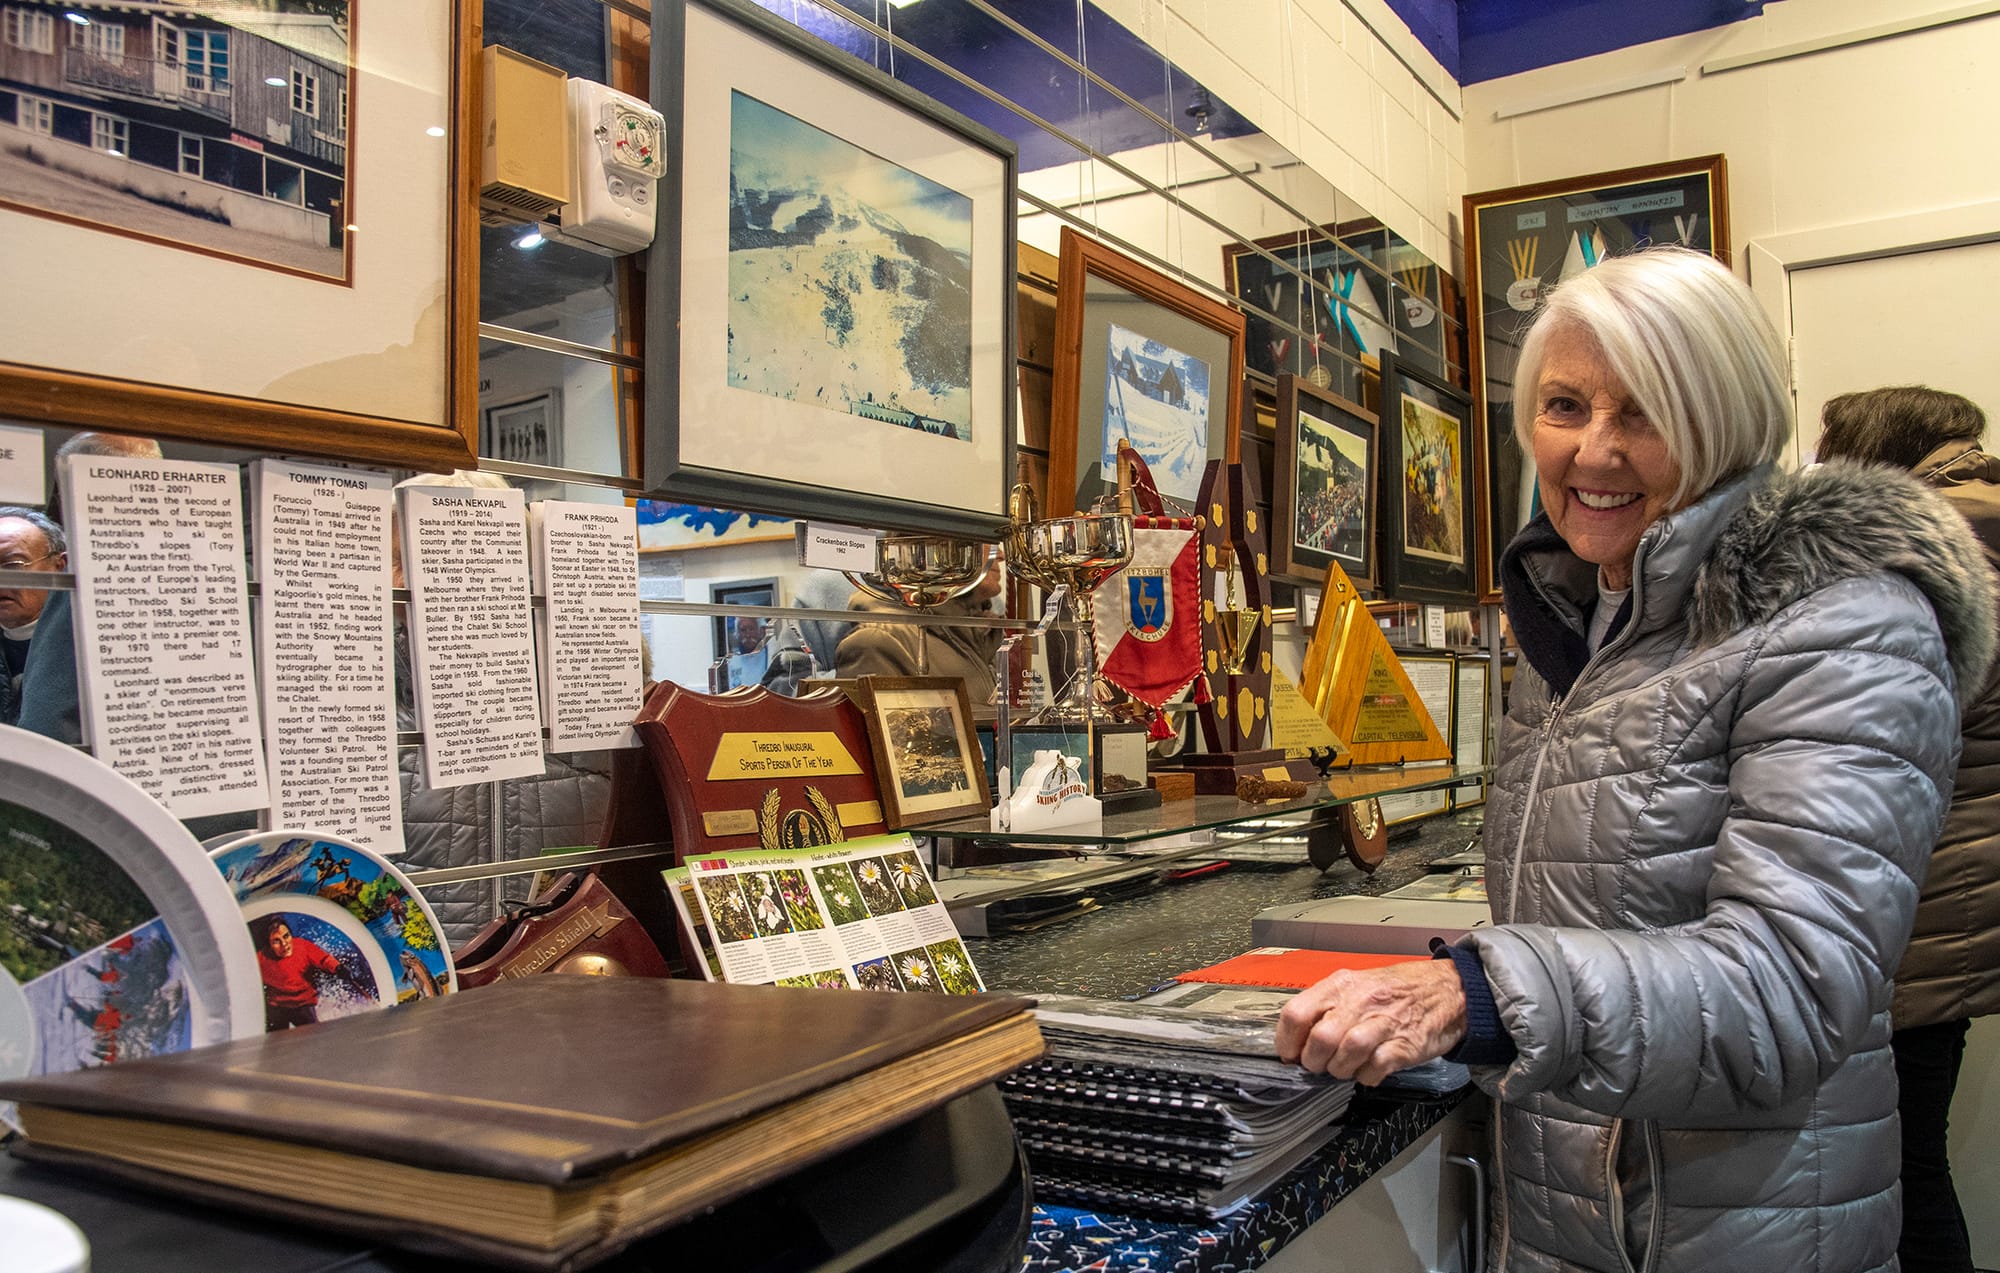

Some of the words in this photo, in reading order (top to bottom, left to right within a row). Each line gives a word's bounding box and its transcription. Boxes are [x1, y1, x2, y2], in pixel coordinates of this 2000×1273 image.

[90, 470, 160, 481] LEONHARD
[163, 473, 226, 484] ERHARTER
[290, 473, 328, 485] TOMMY
[329, 477, 368, 490] TOMASI
[129, 483, 156, 493] (1928
[166, 484, 192, 495] 2007)
[87, 493, 134, 503] Leonhard
[164, 496, 180, 505] the
[184, 498, 217, 506] second
[222, 498, 231, 507] of
[273, 494, 312, 506] Fioruccio
[345, 501, 381, 513] Guiseppe
[432, 498, 464, 507] SASHA
[465, 499, 507, 509] NEKVAPIL
[88, 505, 104, 514] the
[114, 506, 160, 516] hundreds
[169, 507, 180, 516] of
[189, 508, 232, 518] European
[273, 505, 310, 517] (Tommy)
[312, 508, 342, 518] Tomasi
[345, 513, 371, 522] arrived
[449, 509, 468, 518] (1919
[475, 510, 493, 519] 2014)
[89, 518, 142, 527] instructors
[149, 518, 170, 527] who
[176, 519, 199, 528] have
[204, 520, 232, 530] taught
[273, 515, 310, 526] Australia
[328, 520, 346, 529] 1949
[350, 522, 368, 531] after
[419, 518, 441, 526] Sasha
[476, 520, 504, 528] Nekvapil
[273, 527, 297, 535] could
[316, 529, 333, 538] find
[335, 532, 381, 542] employment
[419, 528, 445, 536] Czechs
[474, 530, 501, 538] escaped
[159, 541, 191, 551] slopes
[209, 541, 234, 552] (Tony
[420, 538, 448, 547] country
[485, 538, 522, 546] Communist
[816, 536, 848, 546] Crackenback
[849, 540, 865, 548] Slopes
[274, 547, 302, 558] having
[306, 549, 326, 558] been
[339, 553, 370, 561] partisan
[106, 564, 120, 572] An
[124, 564, 165, 572] Austrian
[167, 563, 190, 572] from
[285, 579, 312, 588] Whilst
[328, 582, 359, 592] working
[469, 576, 484, 585] they
[334, 623, 360, 633] finding
[313, 632, 341, 642] Snowy
[344, 633, 383, 642] Mountains
[114, 677, 160, 688] Leonhard
[186, 673, 231, 684] described
[108, 723, 167, 734] co-ordinator
[176, 718, 230, 729] supervising
[239, 715, 249, 723] all
[1358, 732, 1385, 742] CAPITAL
[1389, 732, 1424, 740] TELEVISION
[1037, 793, 1058, 805] SKIING
[1059, 784, 1085, 799] HISTORY
[510, 946, 558, 979] Thredbo
[555, 915, 591, 949] Shield
